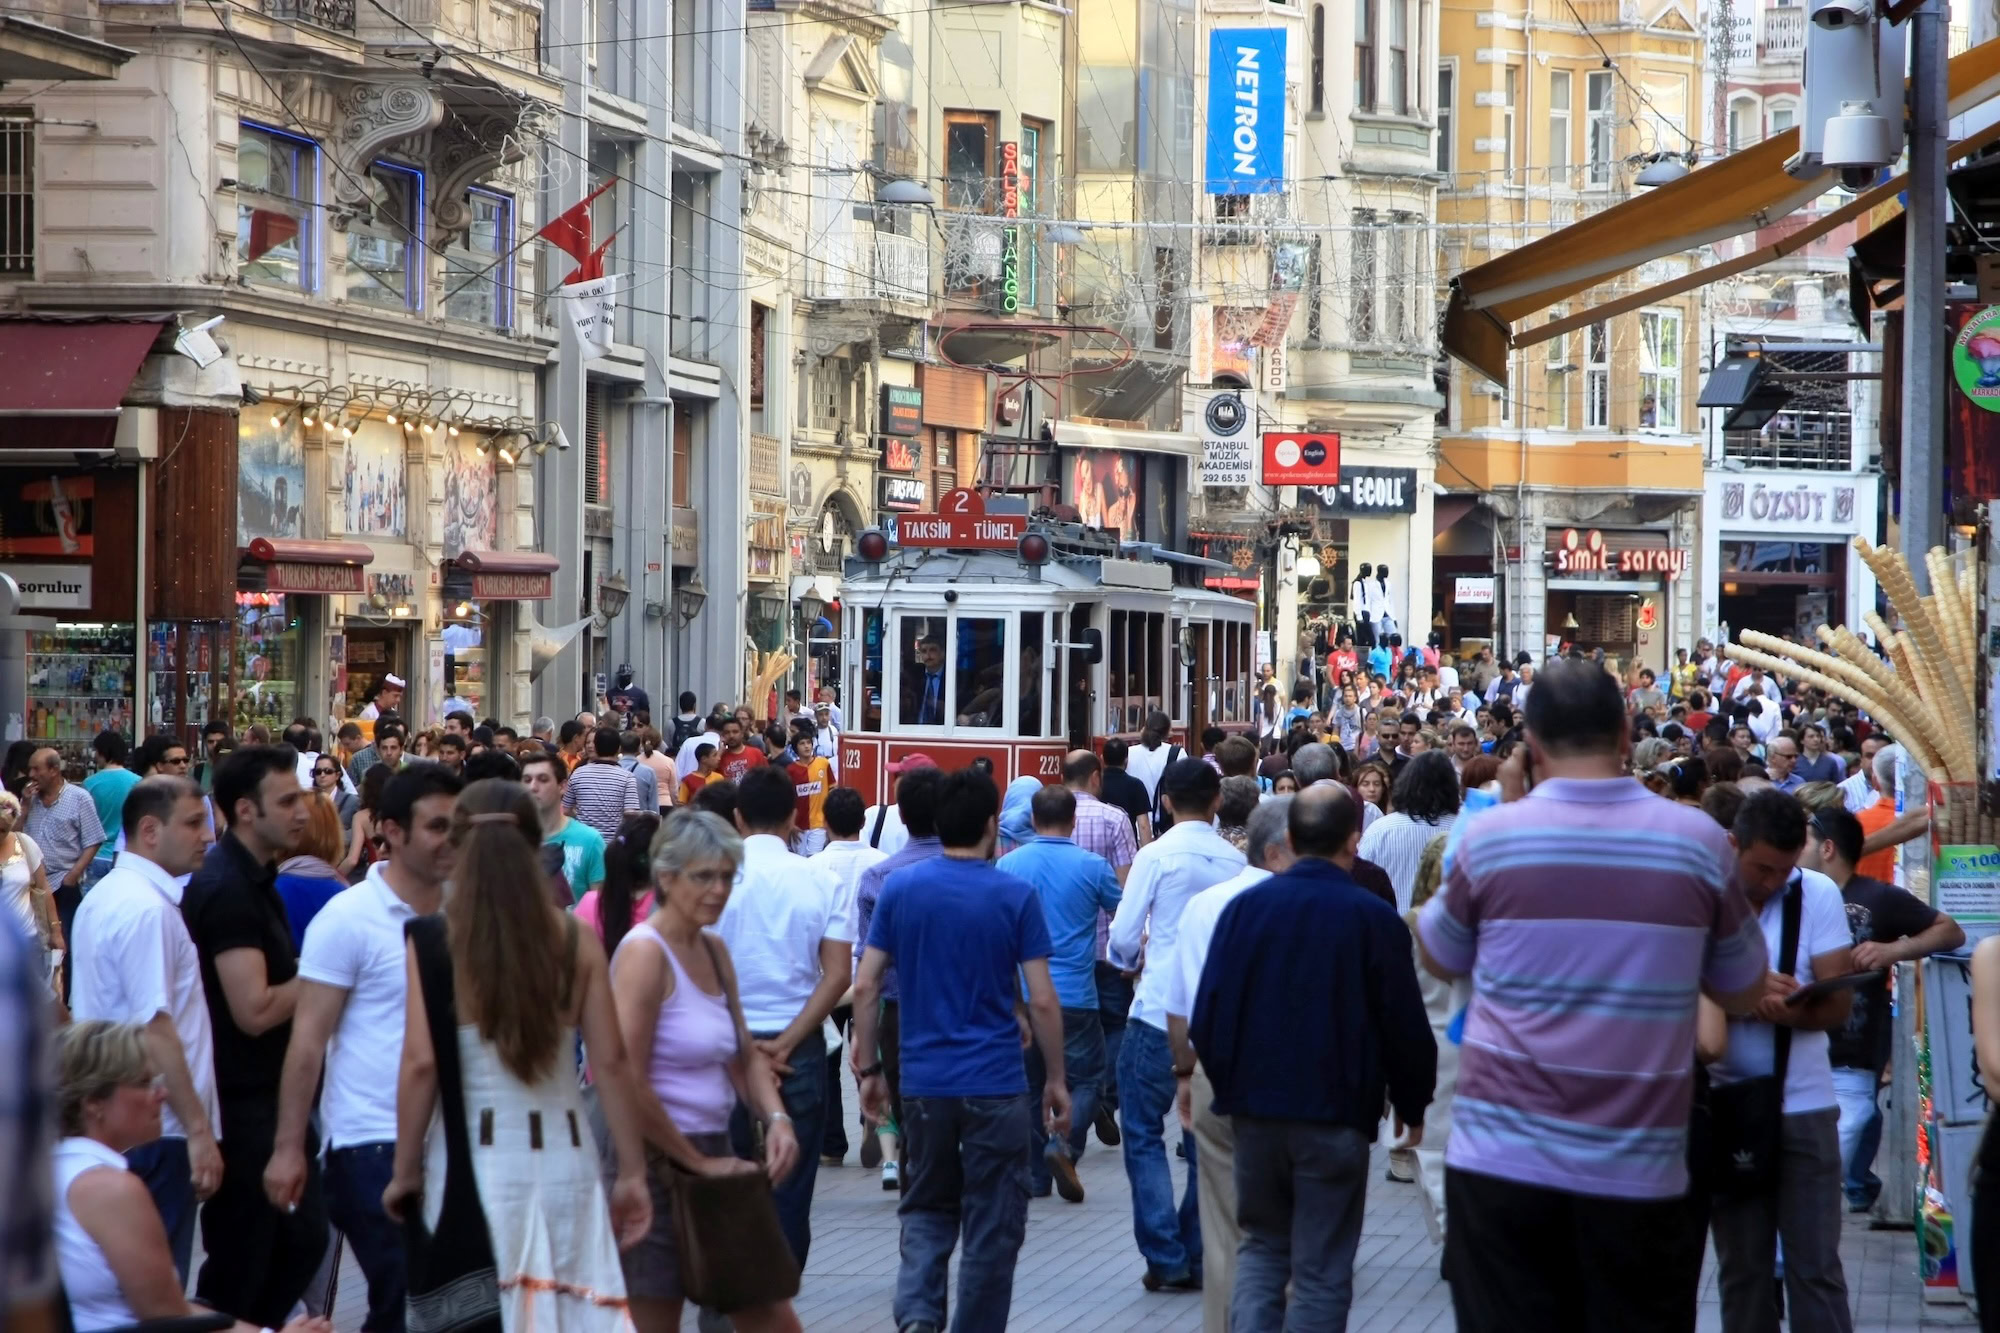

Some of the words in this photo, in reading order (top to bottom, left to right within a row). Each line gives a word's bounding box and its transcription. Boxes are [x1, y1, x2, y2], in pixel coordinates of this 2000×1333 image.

[1233, 46, 1260, 176] NETRON
[1003, 143, 1018, 218] SALSA
[1003, 229, 1018, 311] TANGO
[1209, 448, 1241, 460] MÜZİK
[1304, 449, 1325, 458] English
[1197, 460, 1252, 471] AKADEMİSİ
[1202, 473, 1219, 482] 292
[1221, 474, 1233, 482] 65
[1235, 474, 1246, 482] 35
[955, 491, 969, 513] 2
[1749, 483, 1827, 522] ÖZSÜT
[903, 519, 951, 539] TAKSİM
[973, 520, 1019, 540] TÜNEL
[1556, 528, 1609, 571] simit
[1619, 549, 1689, 581] sarayı
[18, 580, 82, 594] sorulur
[275, 564, 316, 589] TURKISH
[317, 565, 357, 591] SPECIAL
[477, 575, 513, 596] TURKISH
[514, 576, 547, 596] DELIGHT
[846, 749, 861, 769] 223
[1039, 755, 1060, 775] 223
